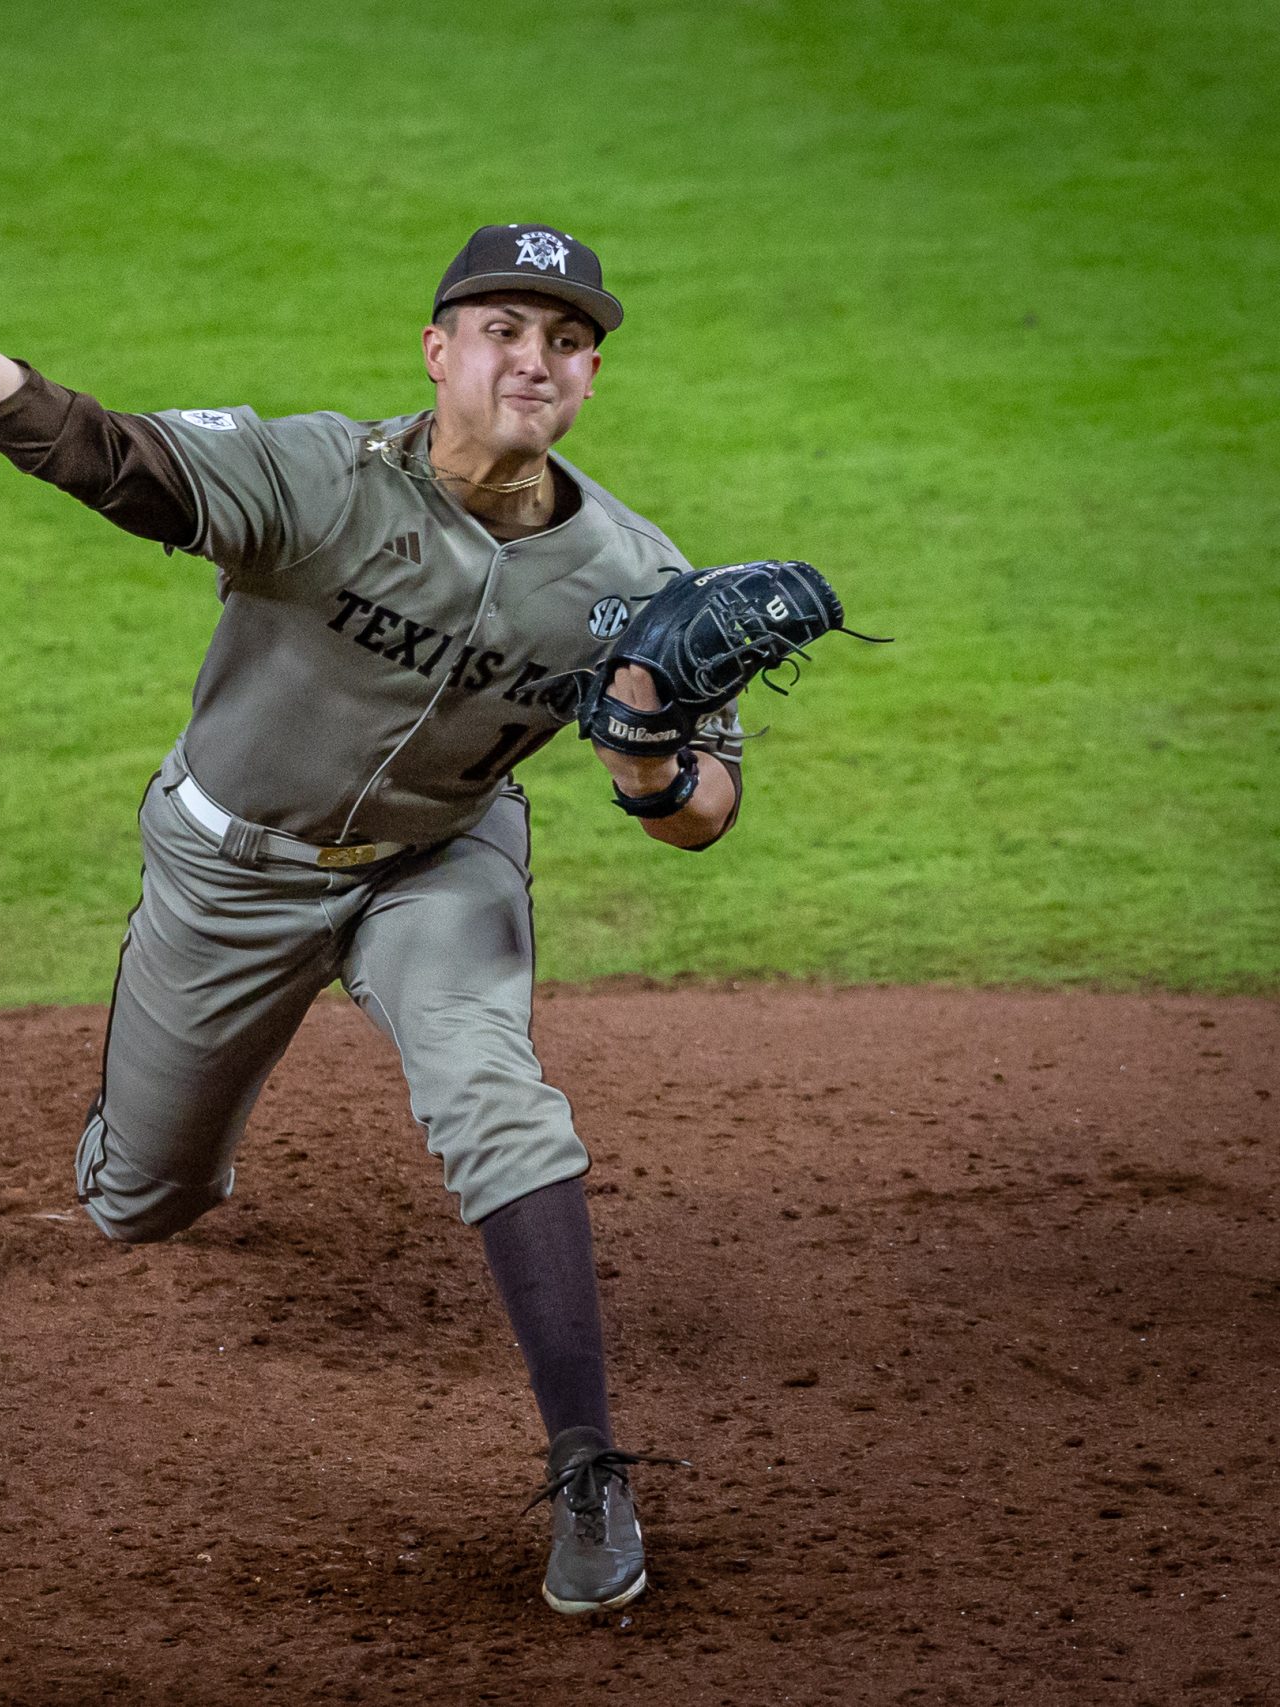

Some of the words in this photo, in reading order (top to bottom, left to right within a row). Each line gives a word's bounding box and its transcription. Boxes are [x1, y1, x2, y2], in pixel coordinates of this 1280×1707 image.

[589, 597, 629, 638] SEC
[327, 589, 504, 690] TEXAS
[608, 715, 678, 742] Wilson
